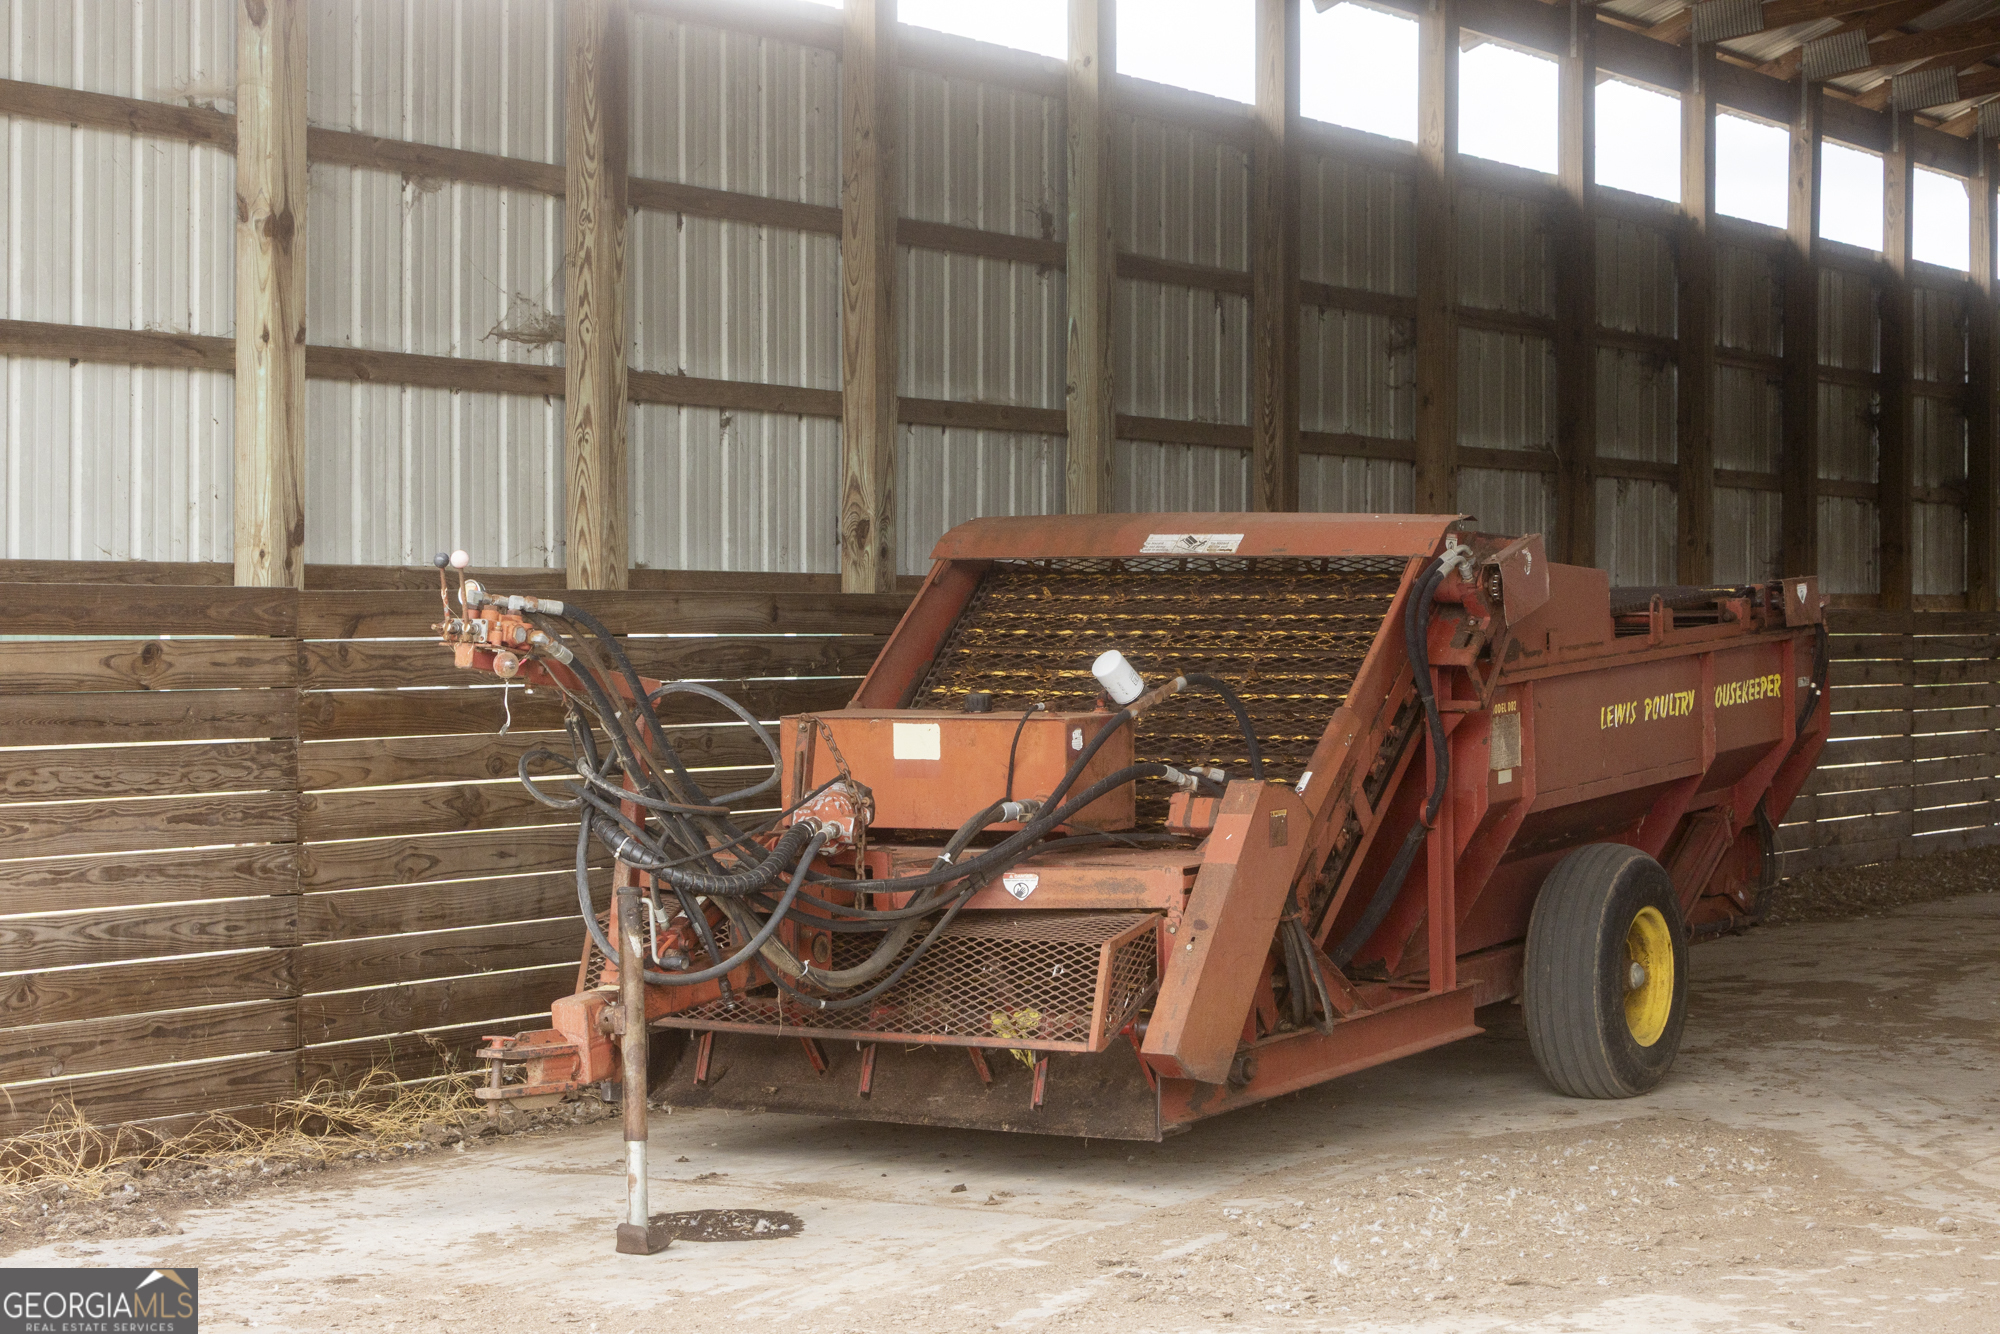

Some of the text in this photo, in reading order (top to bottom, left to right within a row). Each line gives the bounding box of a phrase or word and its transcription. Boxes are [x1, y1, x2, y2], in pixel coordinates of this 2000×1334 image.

[1600, 673, 1781, 730] LEWIS POULTRY OUSEKEEPER
